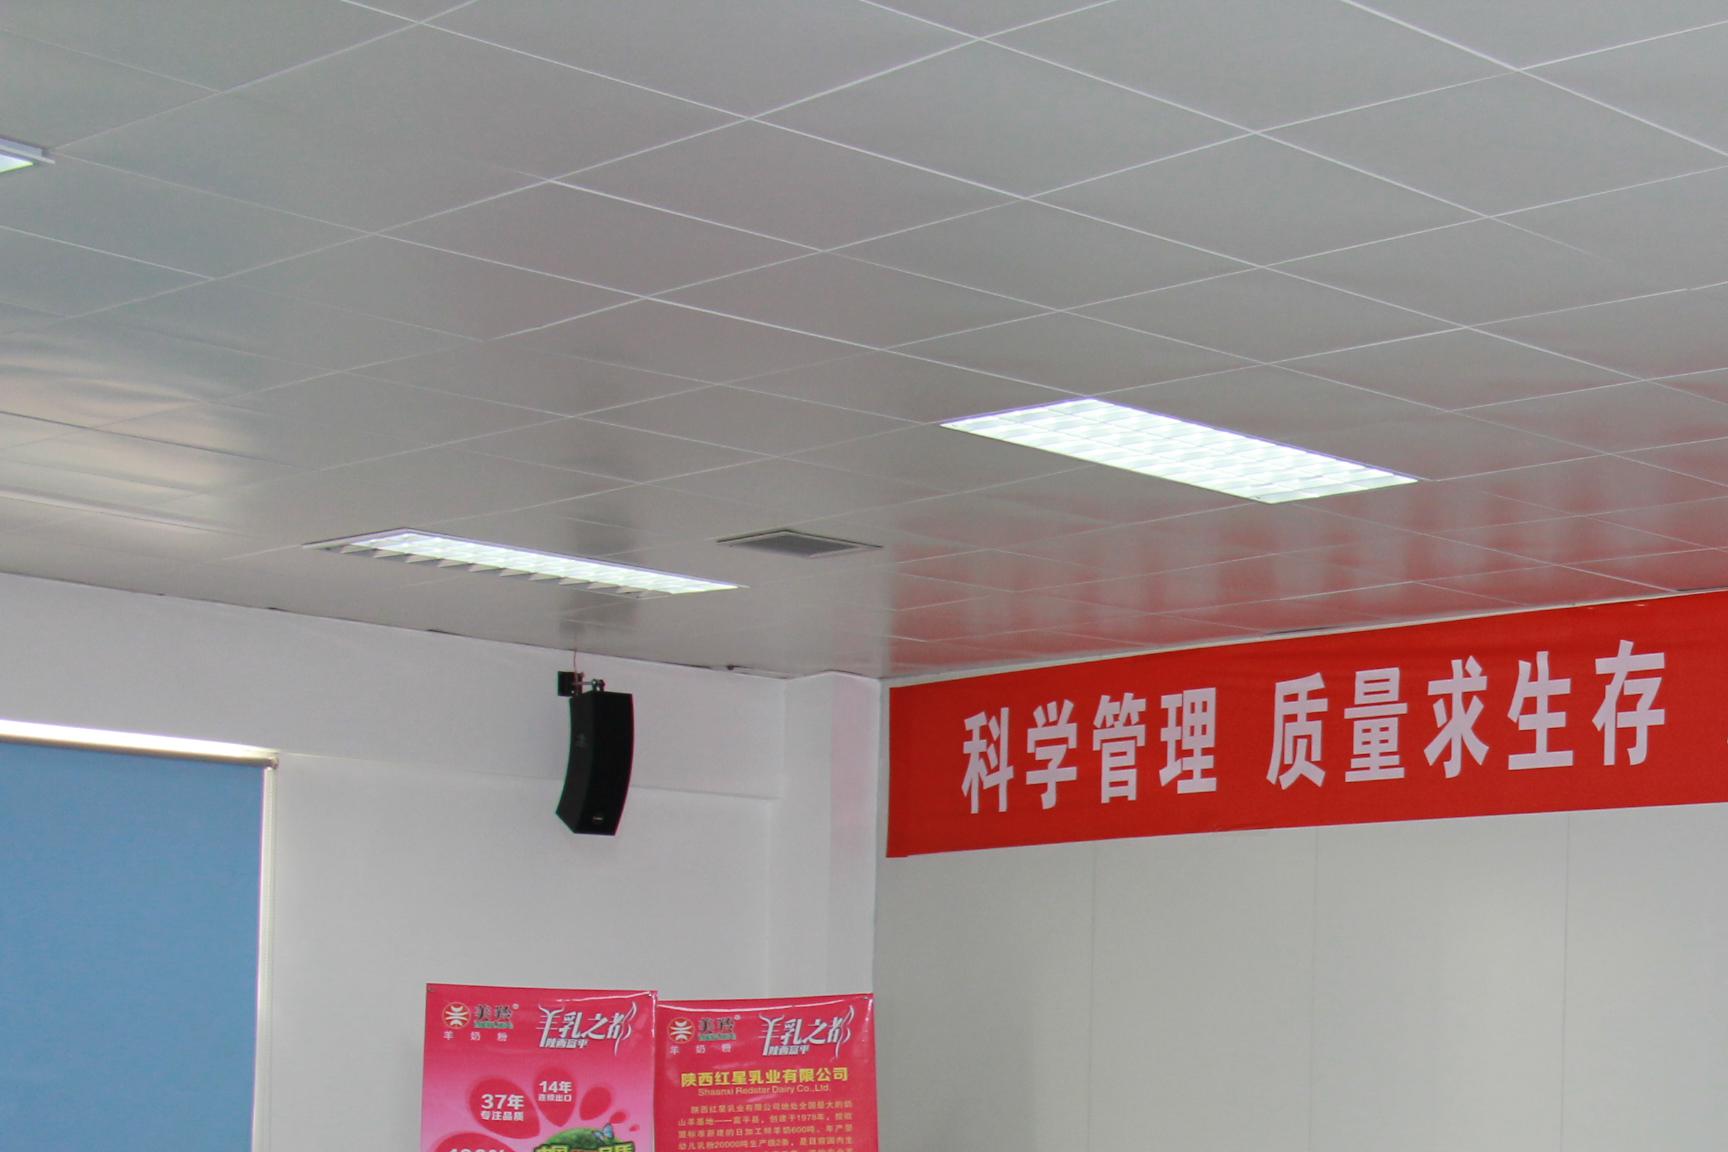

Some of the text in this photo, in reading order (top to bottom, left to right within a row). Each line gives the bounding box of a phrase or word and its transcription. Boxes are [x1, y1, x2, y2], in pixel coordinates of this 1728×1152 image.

[961, 686, 1217, 814] 科学管理
[1266, 640, 1665, 790] 质量求生存
[681, 1067, 848, 1087] 陕西红星乳业有限公司
[539, 1081, 572, 1093] 14年
[481, 1094, 524, 1109] 37年
[480, 1111, 524, 1121] 专注品质
